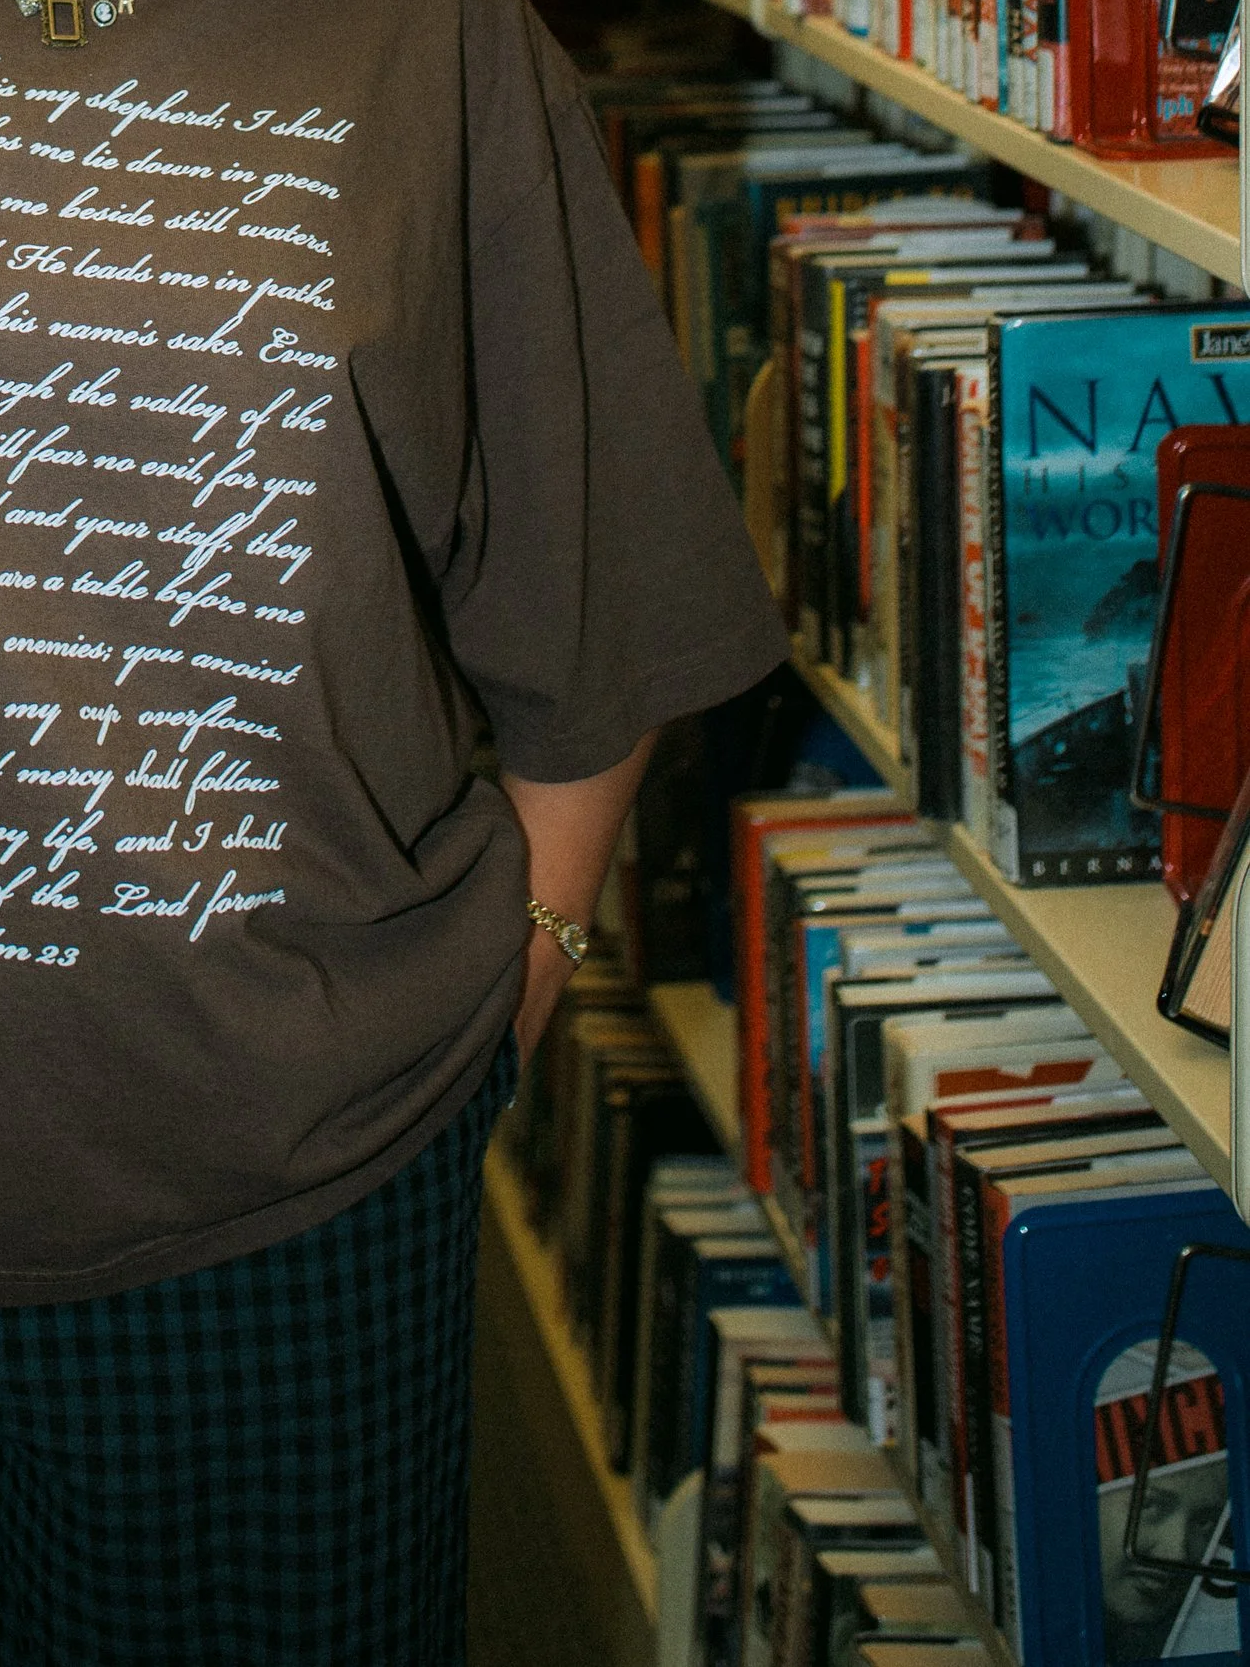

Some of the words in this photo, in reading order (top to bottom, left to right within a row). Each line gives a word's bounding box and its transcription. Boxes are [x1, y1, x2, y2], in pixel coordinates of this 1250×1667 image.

[24, 89, 80, 123] my
[85, 79, 231, 137] shepherd;
[233, 110, 277, 131] I
[270, 107, 355, 143] shall
[30, 142, 76, 163] me
[82, 141, 120, 170] lie
[126, 148, 214, 178] down
[220, 162, 257, 183] in
[242, 173, 340, 205] green
[0, 197, 49, 215] me
[58, 186, 155, 226] beside
[164, 207, 239, 233] still
[238, 224, 332, 256] waters.
[7, 244, 73, 274] He
[72, 248, 154, 282] leads
[158, 272, 210, 288] me
[214, 270, 252, 292] in
[239, 278, 335, 323] paths
[48, 320, 158, 346] name's
[167, 315, 243, 357] sake.
[259, 328, 338, 370] Even
[68, 368, 121, 406] the
[130, 384, 227, 443] valley
[236, 388, 296, 449] of
[281, 394, 333, 432] the
[7, 425, 88, 484] fear
[93, 456, 136, 472] no
[141, 452, 215, 484] evil,
[192, 449, 258, 508] for
[250, 477, 317, 520] you
[5, 499, 83, 527] and
[64, 517, 150, 555] your
[157, 511, 256, 572] staff,
[246, 519, 312, 584] they
[43, 577, 65, 591] a
[71, 561, 150, 600] table
[154, 568, 247, 627] before
[254, 606, 305, 624] me
[3, 635, 113, 662] enemies;
[115, 646, 184, 686] you
[191, 654, 303, 685] anoint
[4, 704, 62, 746] my
[79, 704, 121, 746] cup
[138, 696, 282, 753] overflows.
[17, 767, 114, 813] mercy
[125, 749, 188, 789] shall
[185, 751, 280, 815] follow
[43, 810, 104, 872] life,
[115, 820, 178, 853] and
[183, 822, 214, 852] I
[221, 815, 288, 851] shall
[31, 871, 80, 909] the
[100, 881, 201, 917] Lord
[35, 946, 80, 967] 23
